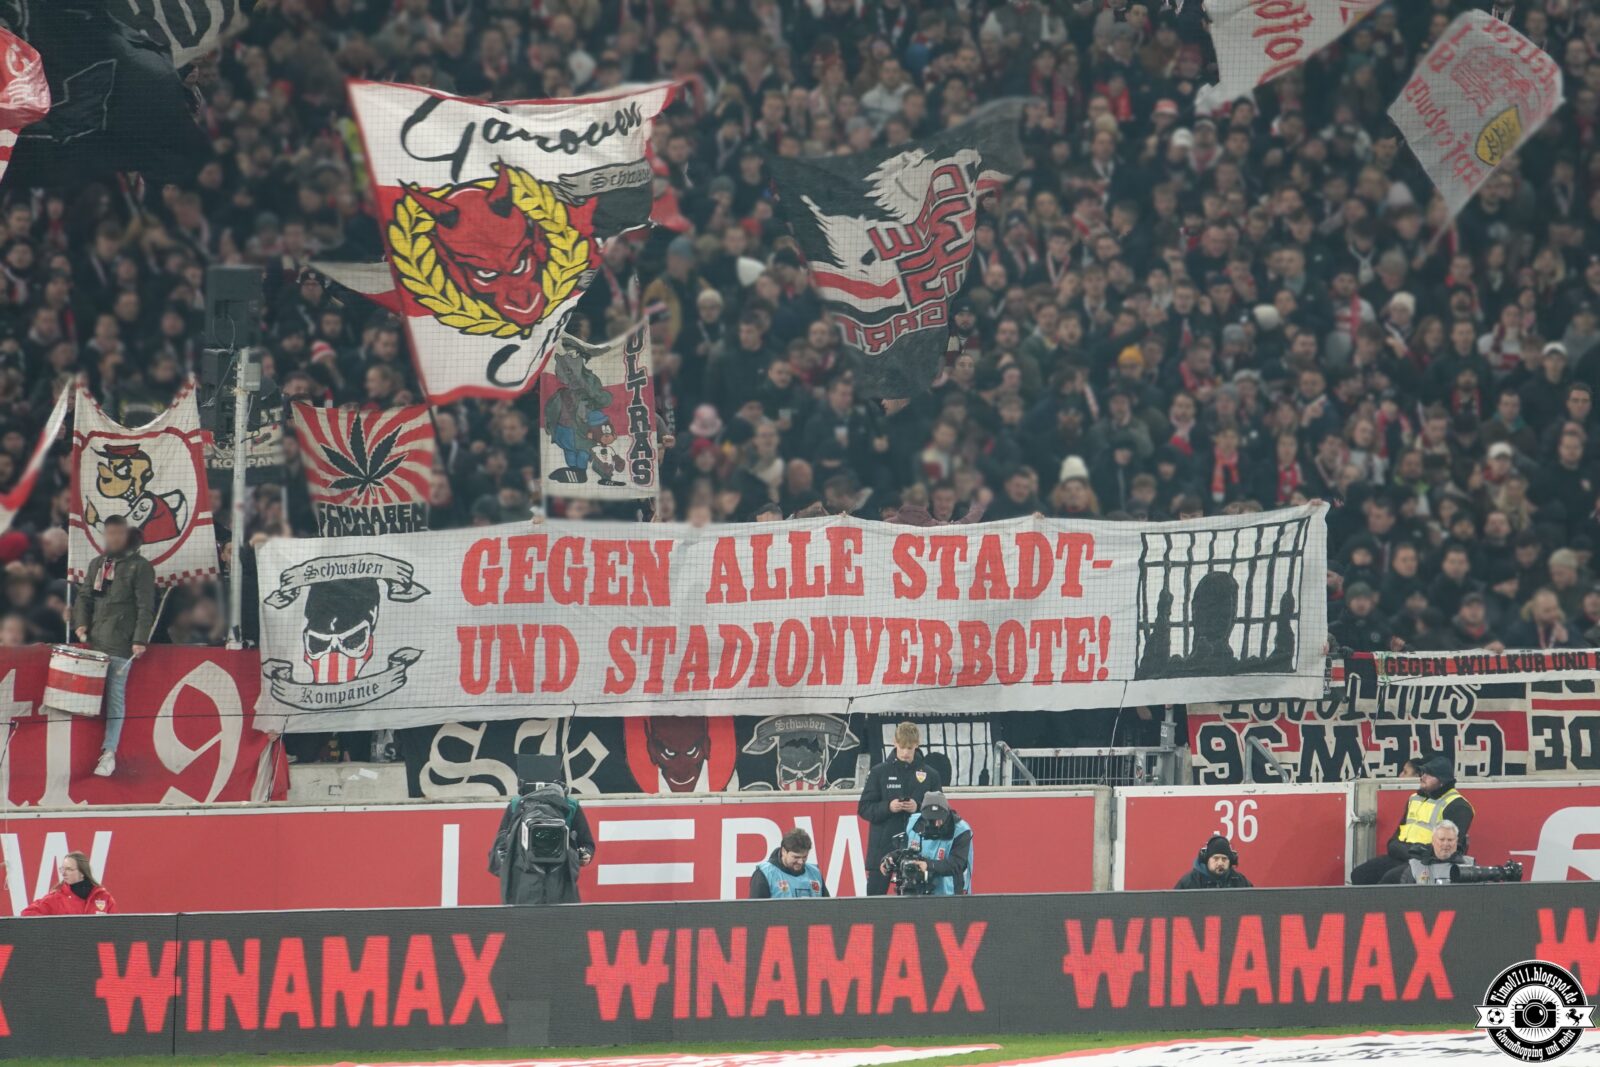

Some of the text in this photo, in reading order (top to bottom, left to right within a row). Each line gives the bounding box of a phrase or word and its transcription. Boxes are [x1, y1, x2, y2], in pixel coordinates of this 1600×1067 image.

[624, 322, 656, 486] ULTRAS
[318, 502, 426, 524] SCHWABEN
[304, 560, 383, 581] Schwaben
[461, 527, 1112, 606] GEGEN ALLE STADT-
[457, 615, 1111, 694] UND STADIONVERBOTE!
[1385, 656, 1447, 676] GEGEN
[1552, 651, 1588, 670] UND
[301, 683, 380, 704] Kompanie
[775, 719, 826, 731] Schwaben
[1213, 799, 1258, 843] 36
[95, 932, 505, 1035] WINAMAX
[585, 921, 988, 1022] WINAMAX
[1062, 910, 1456, 1009] WINAMAX
